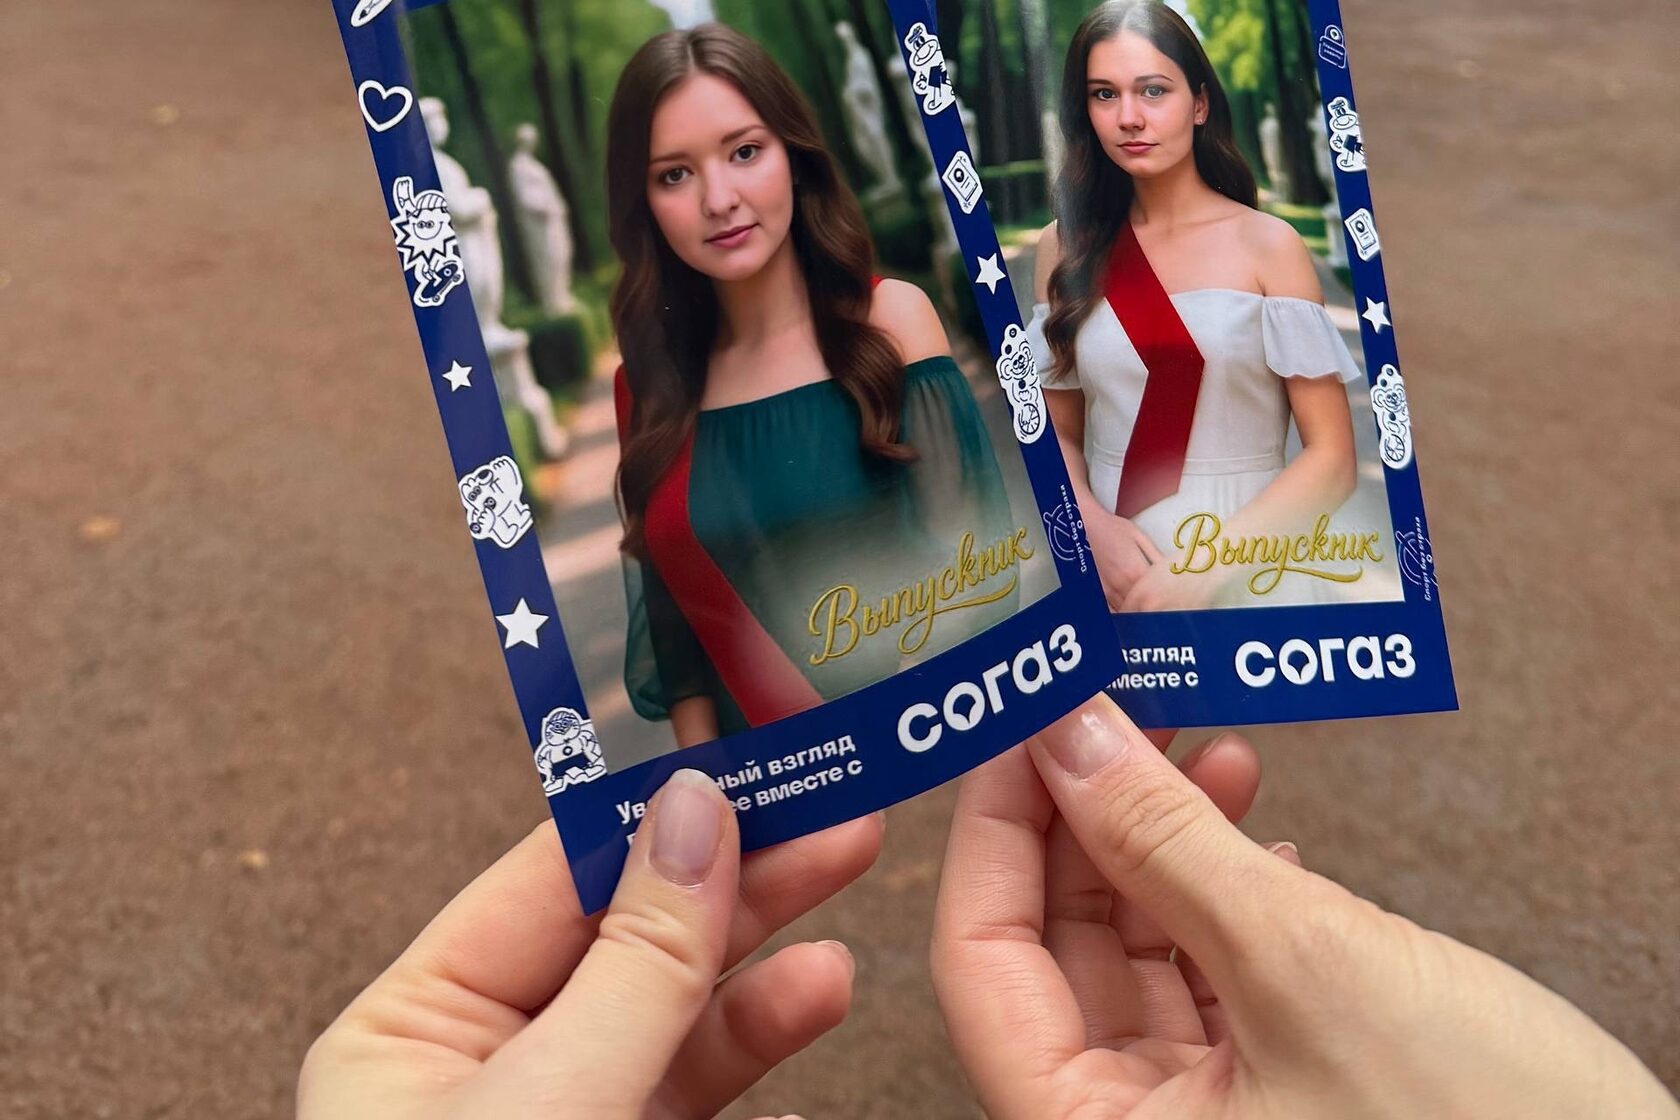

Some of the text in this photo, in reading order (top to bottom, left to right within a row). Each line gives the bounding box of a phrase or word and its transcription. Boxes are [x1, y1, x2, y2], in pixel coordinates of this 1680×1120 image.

[1170, 511, 1384, 596] Выпускник
[808, 526, 1035, 666] Выпускник
[1106, 671, 1199, 689] месте с
[767, 734, 856, 776] взгляд
[755, 764, 844, 807] вместе
[847, 759, 863, 775] с
